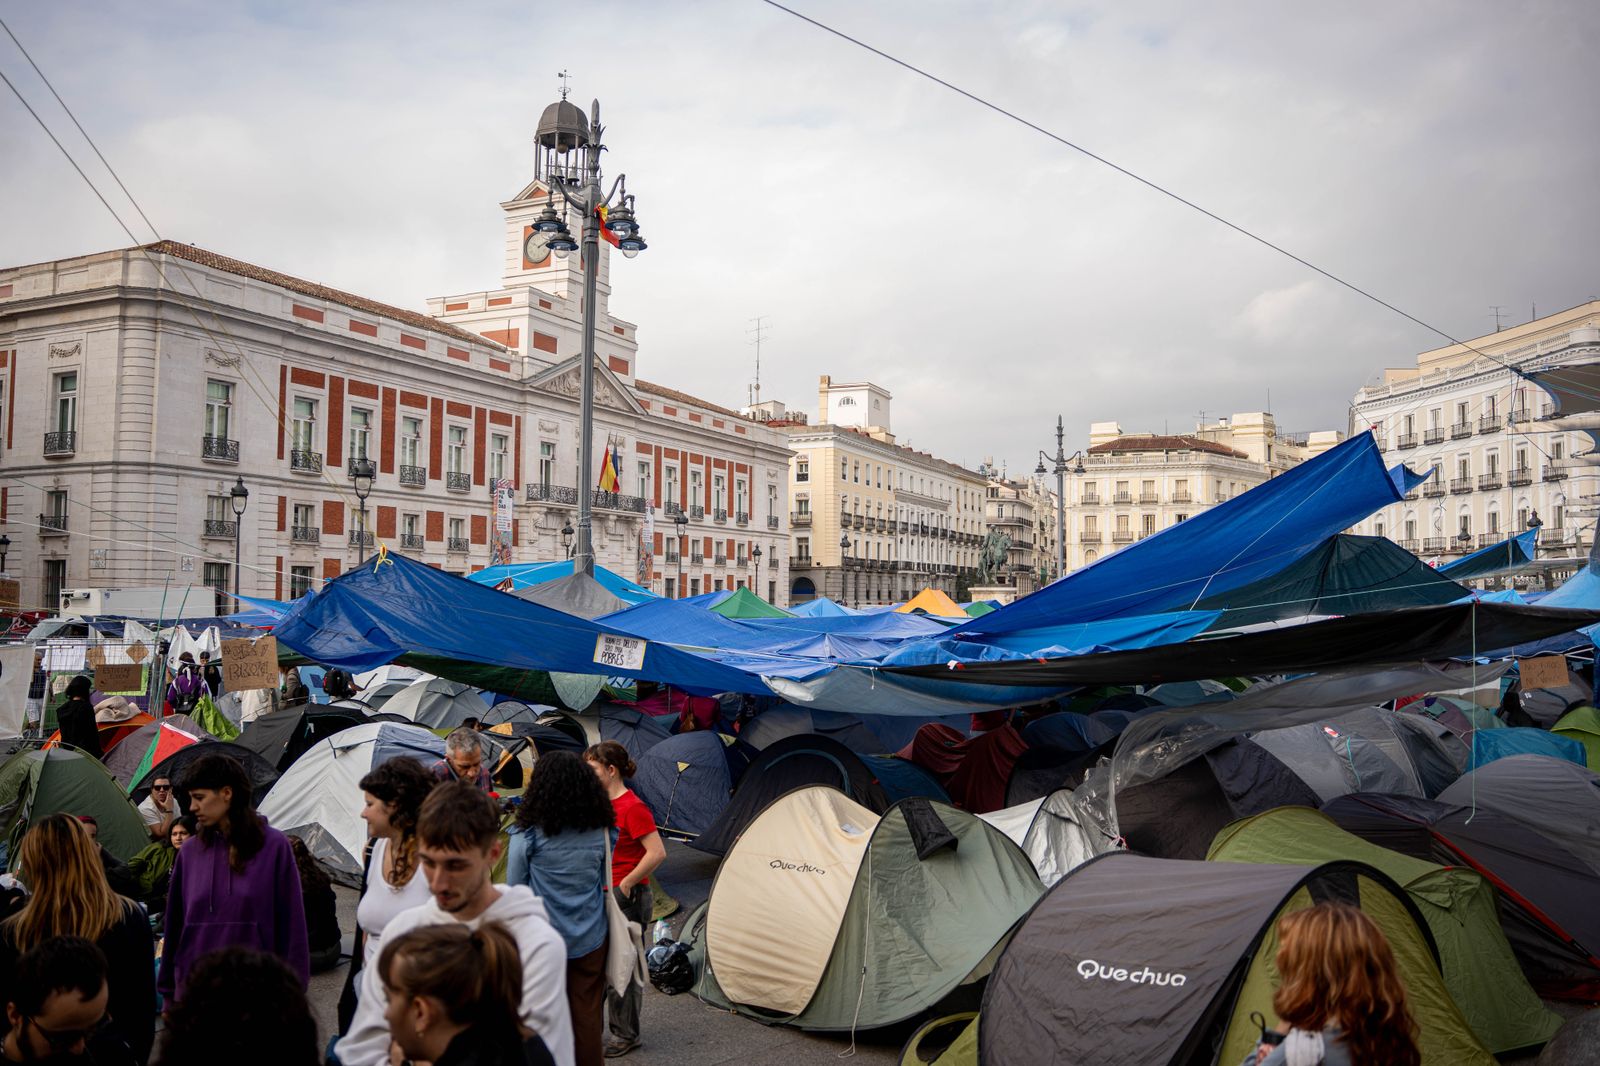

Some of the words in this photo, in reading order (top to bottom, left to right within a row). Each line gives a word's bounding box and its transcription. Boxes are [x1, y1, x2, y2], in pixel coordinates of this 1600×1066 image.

[623, 639, 638, 649] DELITO
[601, 651, 624, 665] POBRES
[770, 859, 826, 875] Quechua
[1077, 959, 1187, 987] Quechua
